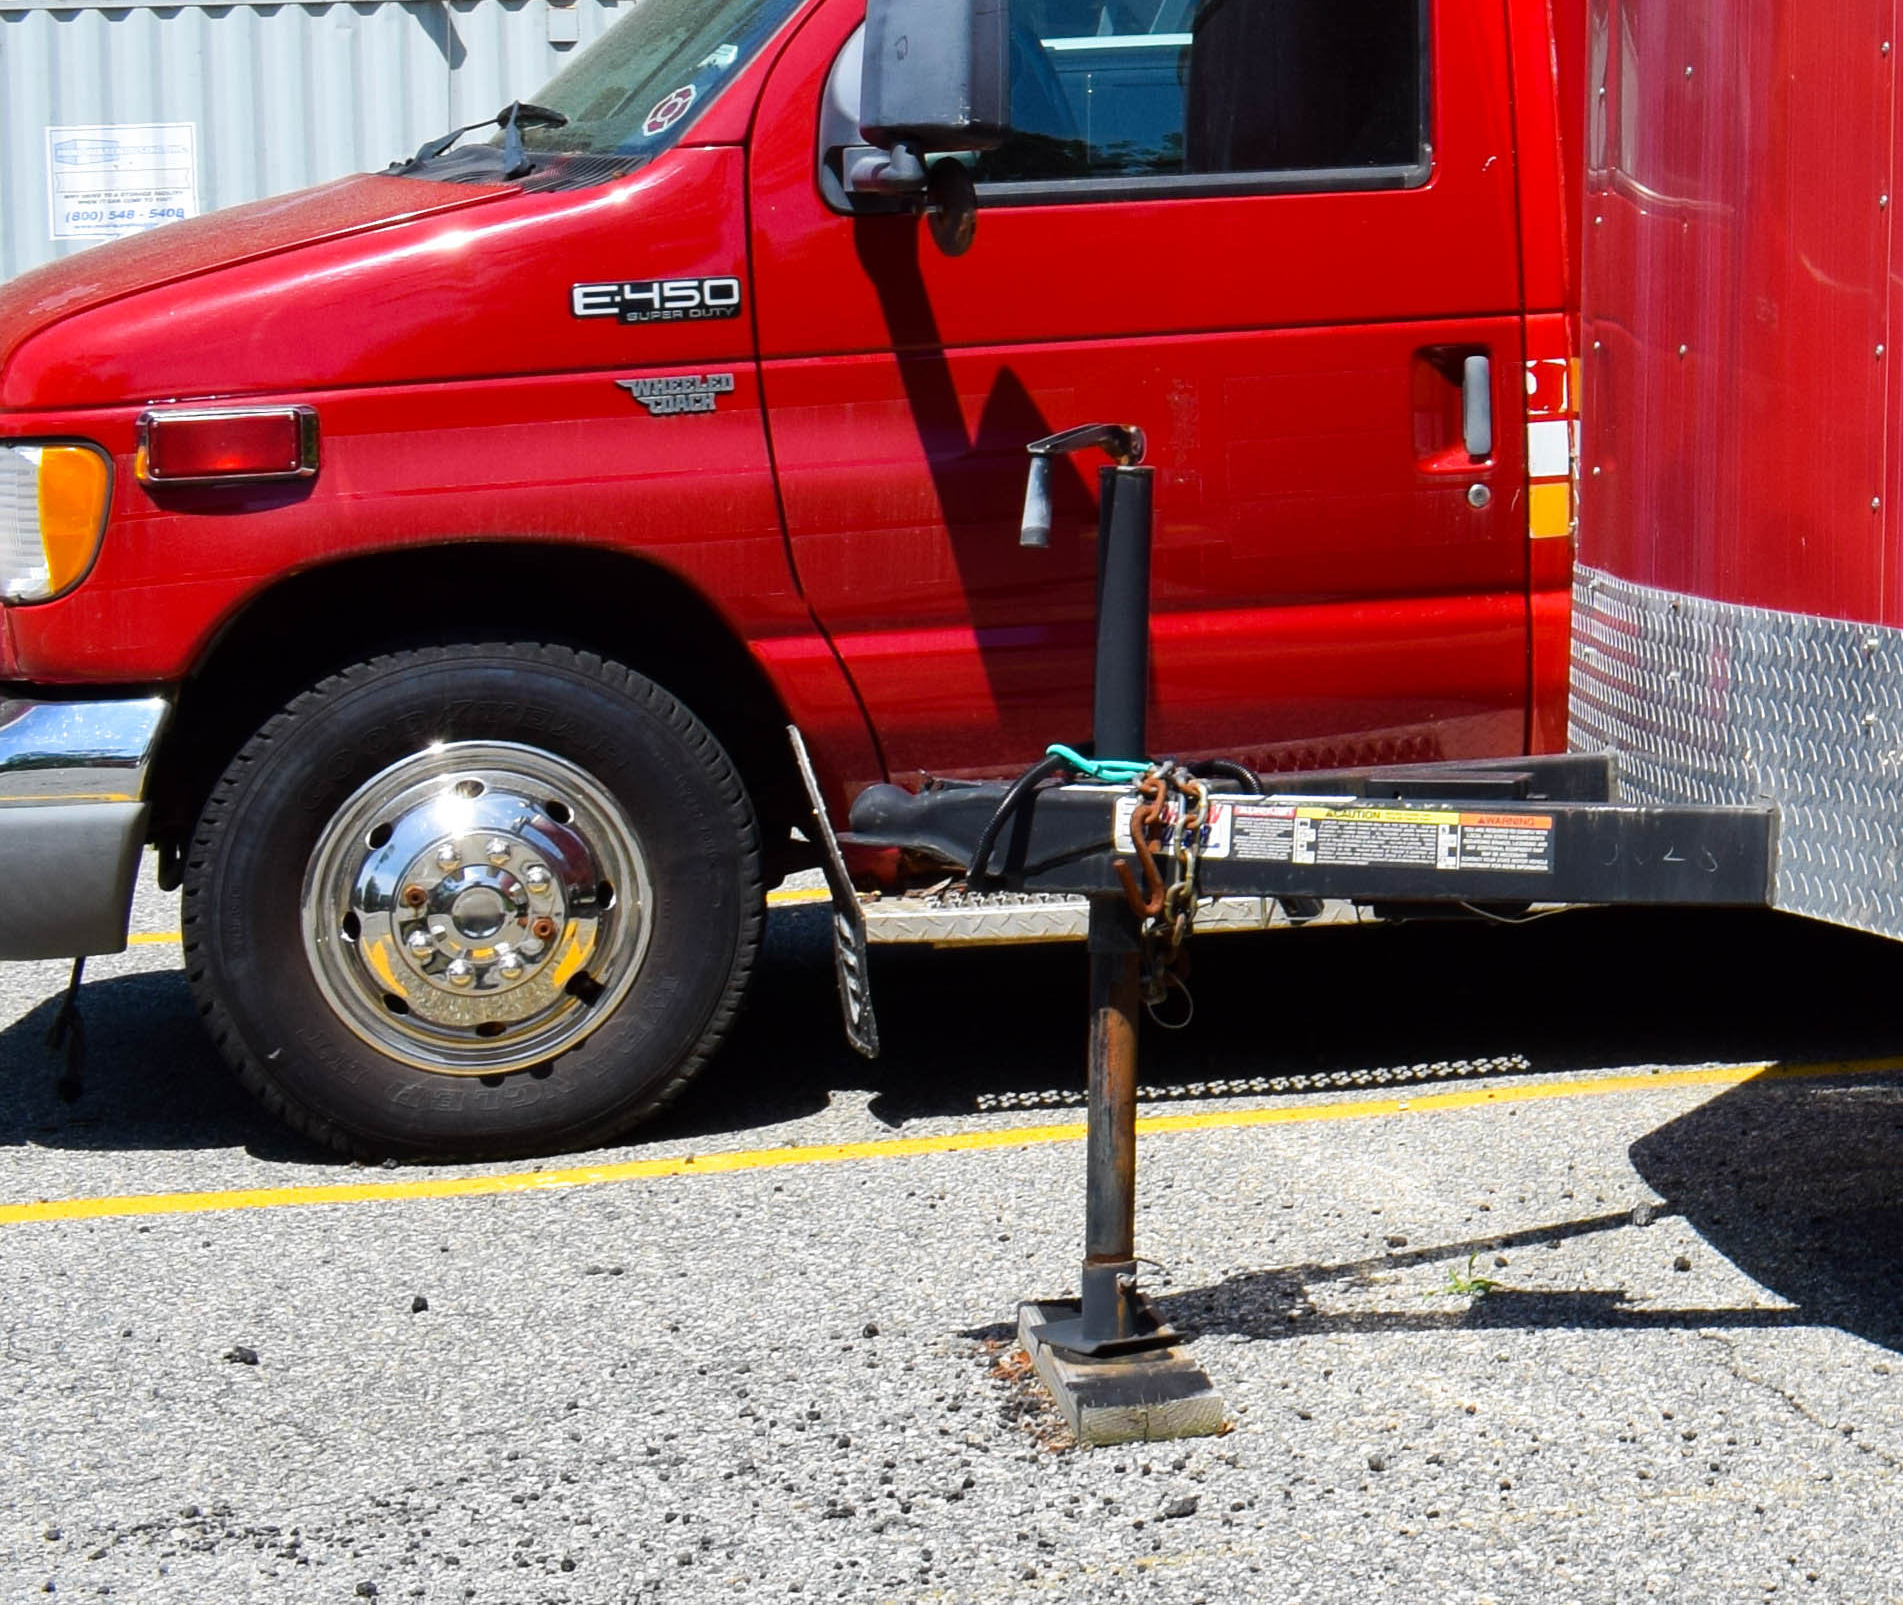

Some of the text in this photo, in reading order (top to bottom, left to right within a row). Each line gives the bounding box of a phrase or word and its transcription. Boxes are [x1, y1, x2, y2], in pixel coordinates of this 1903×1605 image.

[65, 211, 104, 223] (800)
[108, 210, 135, 220] 548
[626, 307, 735, 322] SUPER DUTY
[630, 373, 735, 397] WHEELED
[647, 393, 717, 414] COACH
[1335, 809, 1381, 819] CAUTION
[1486, 816, 1535, 826] WARNING
